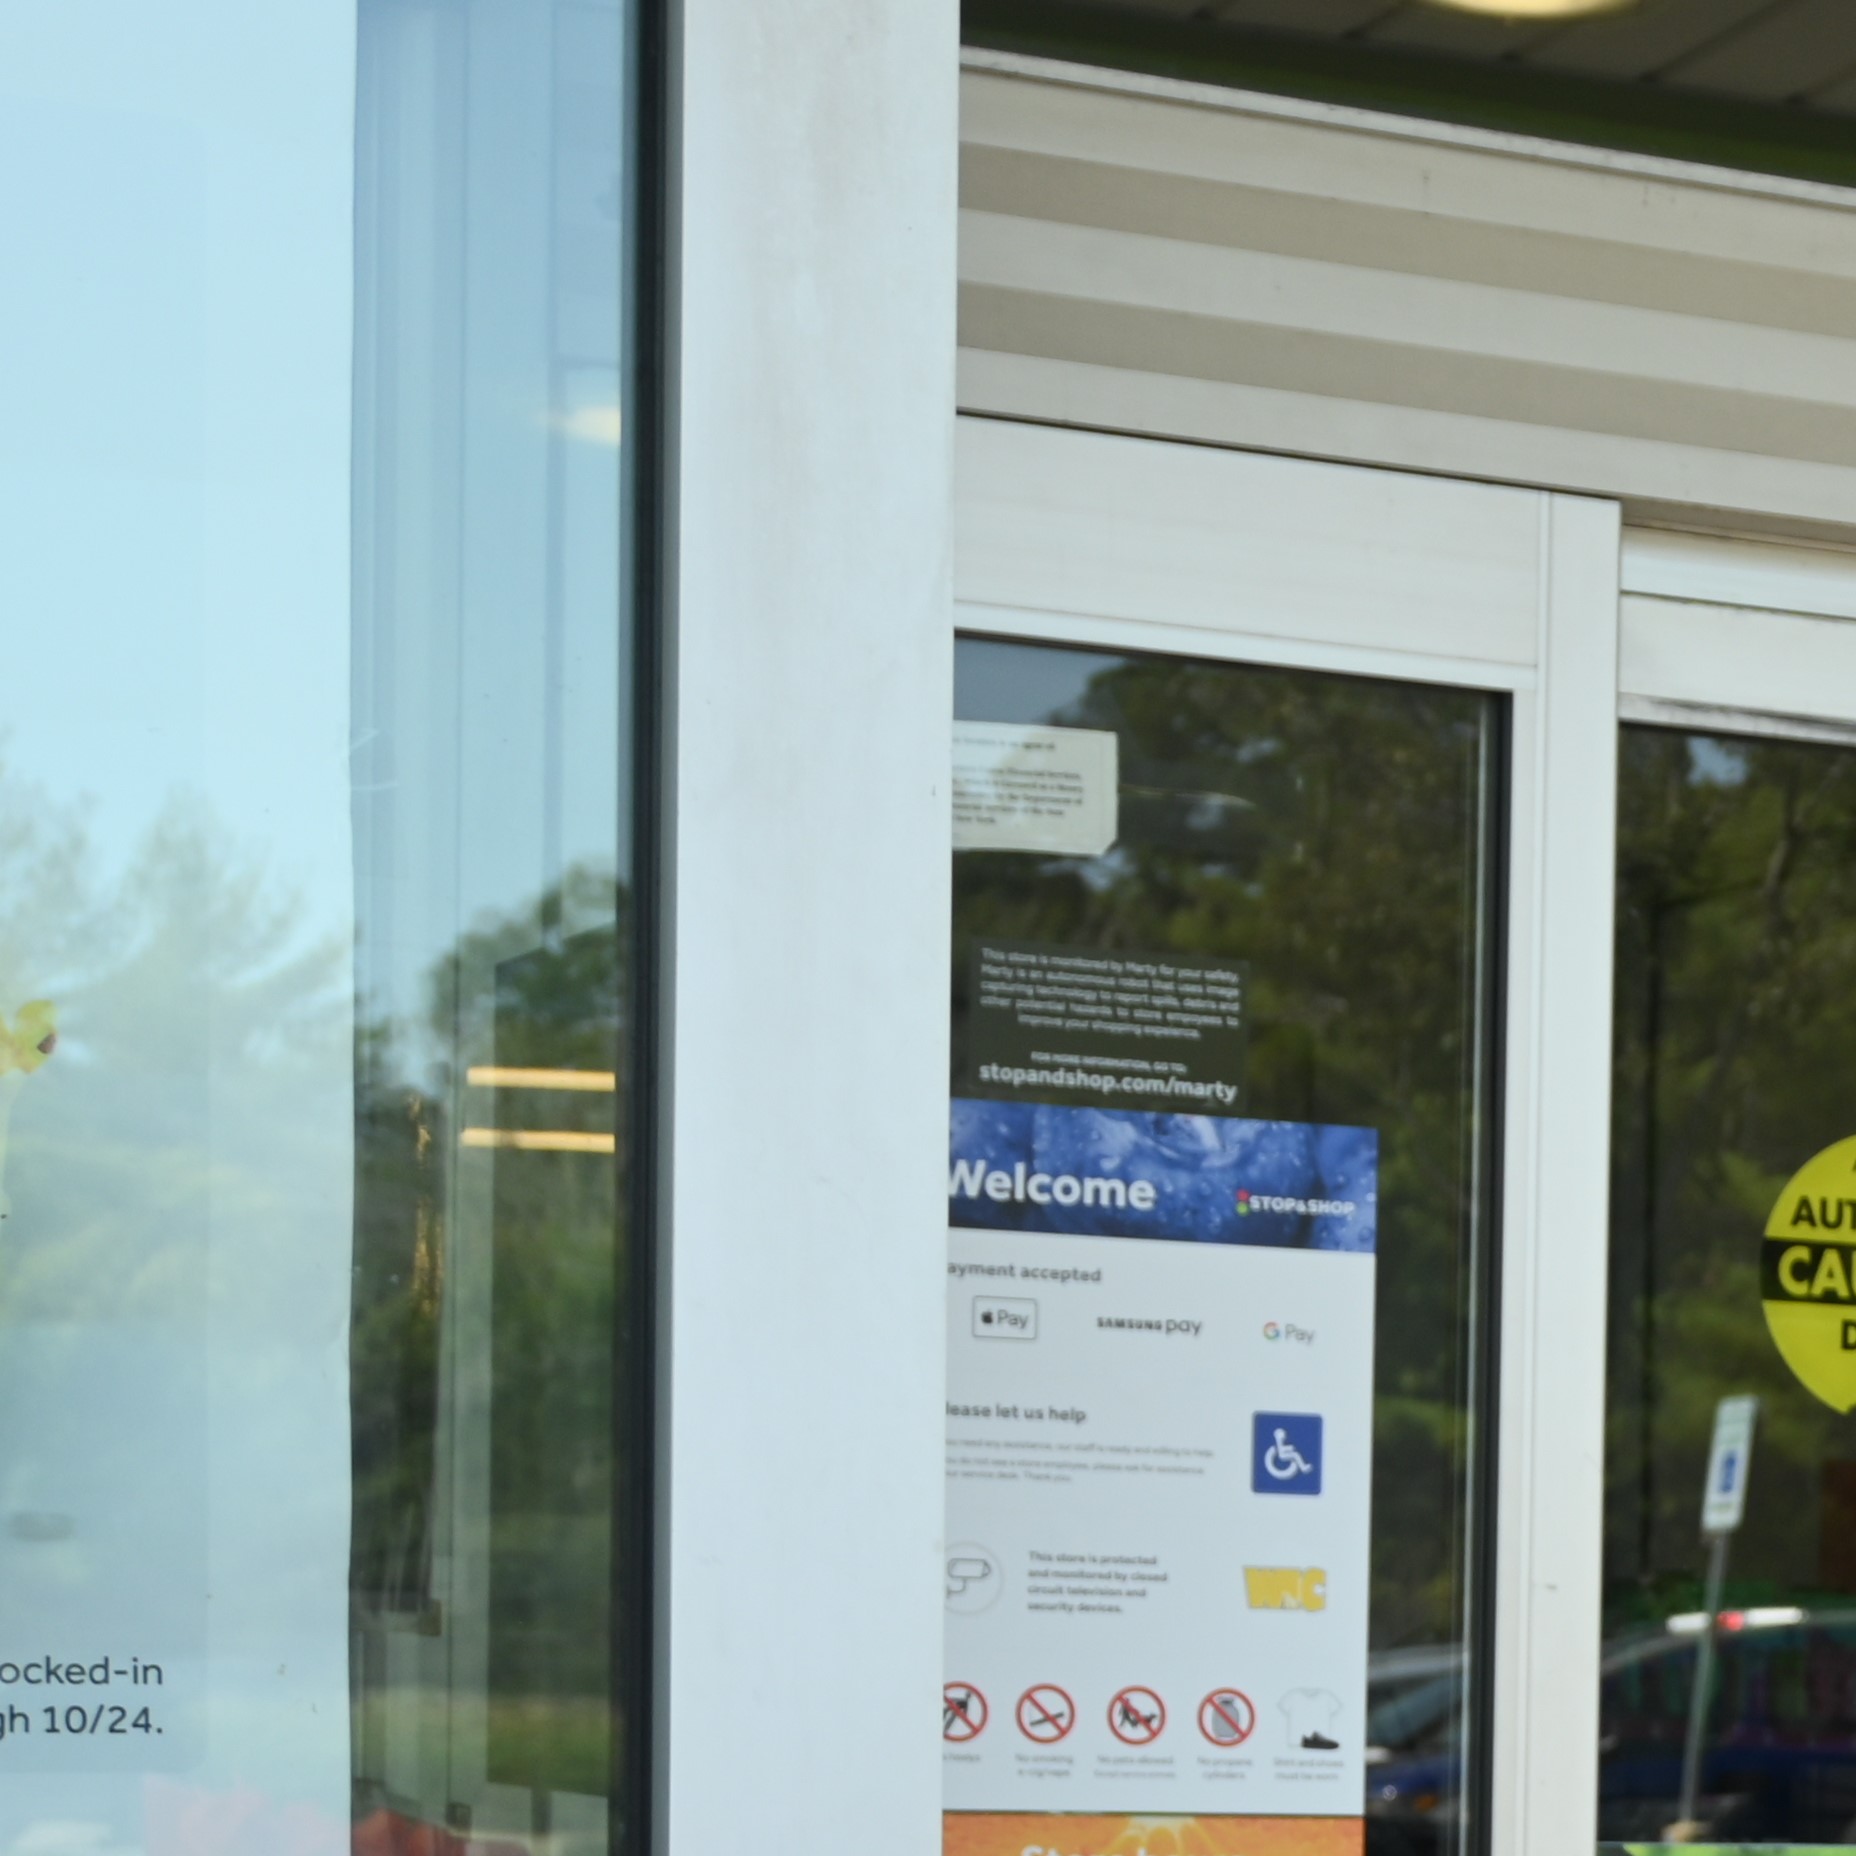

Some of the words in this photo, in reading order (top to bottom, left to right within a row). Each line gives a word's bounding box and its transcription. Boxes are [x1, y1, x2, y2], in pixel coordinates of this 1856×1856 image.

[981, 962, 1013, 978] Marty
[1125, 960, 1157, 976] Marty
[980, 1063, 1238, 1104] stopandshop.com/marty
[948, 1158, 1156, 1212] Welcome
[947, 1262, 1016, 1279] ayment
[1020, 1265, 1102, 1285] accepted
[997, 1309, 1029, 1330] Pay
[1097, 1316, 1162, 1331] SAMSUNG
[1165, 1318, 1202, 1336] pay
[1285, 1324, 1315, 1344] Pay
[995, 1403, 1018, 1420] let
[1023, 1407, 1044, 1421] us
[1048, 1405, 1086, 1424] help
[1028, 1550, 1052, 1562] This
[1056, 1553, 1086, 1563] store
[1087, 1553, 1098, 1563] is
[1099, 1553, 1158, 1566] protected
[1028, 1568, 1049, 1578] and
[1051, 1569, 1112, 1581] monitored
[1114, 1571, 1127, 1582] by
[1125, 1587, 1147, 1597] and
[1027, 1601, 1074, 1613] security
[1077, 1602, 1122, 1614] devices.
[0, 1655, 163, 1685] ocked-in
[43, 1704, 163, 1734] 10/24.
